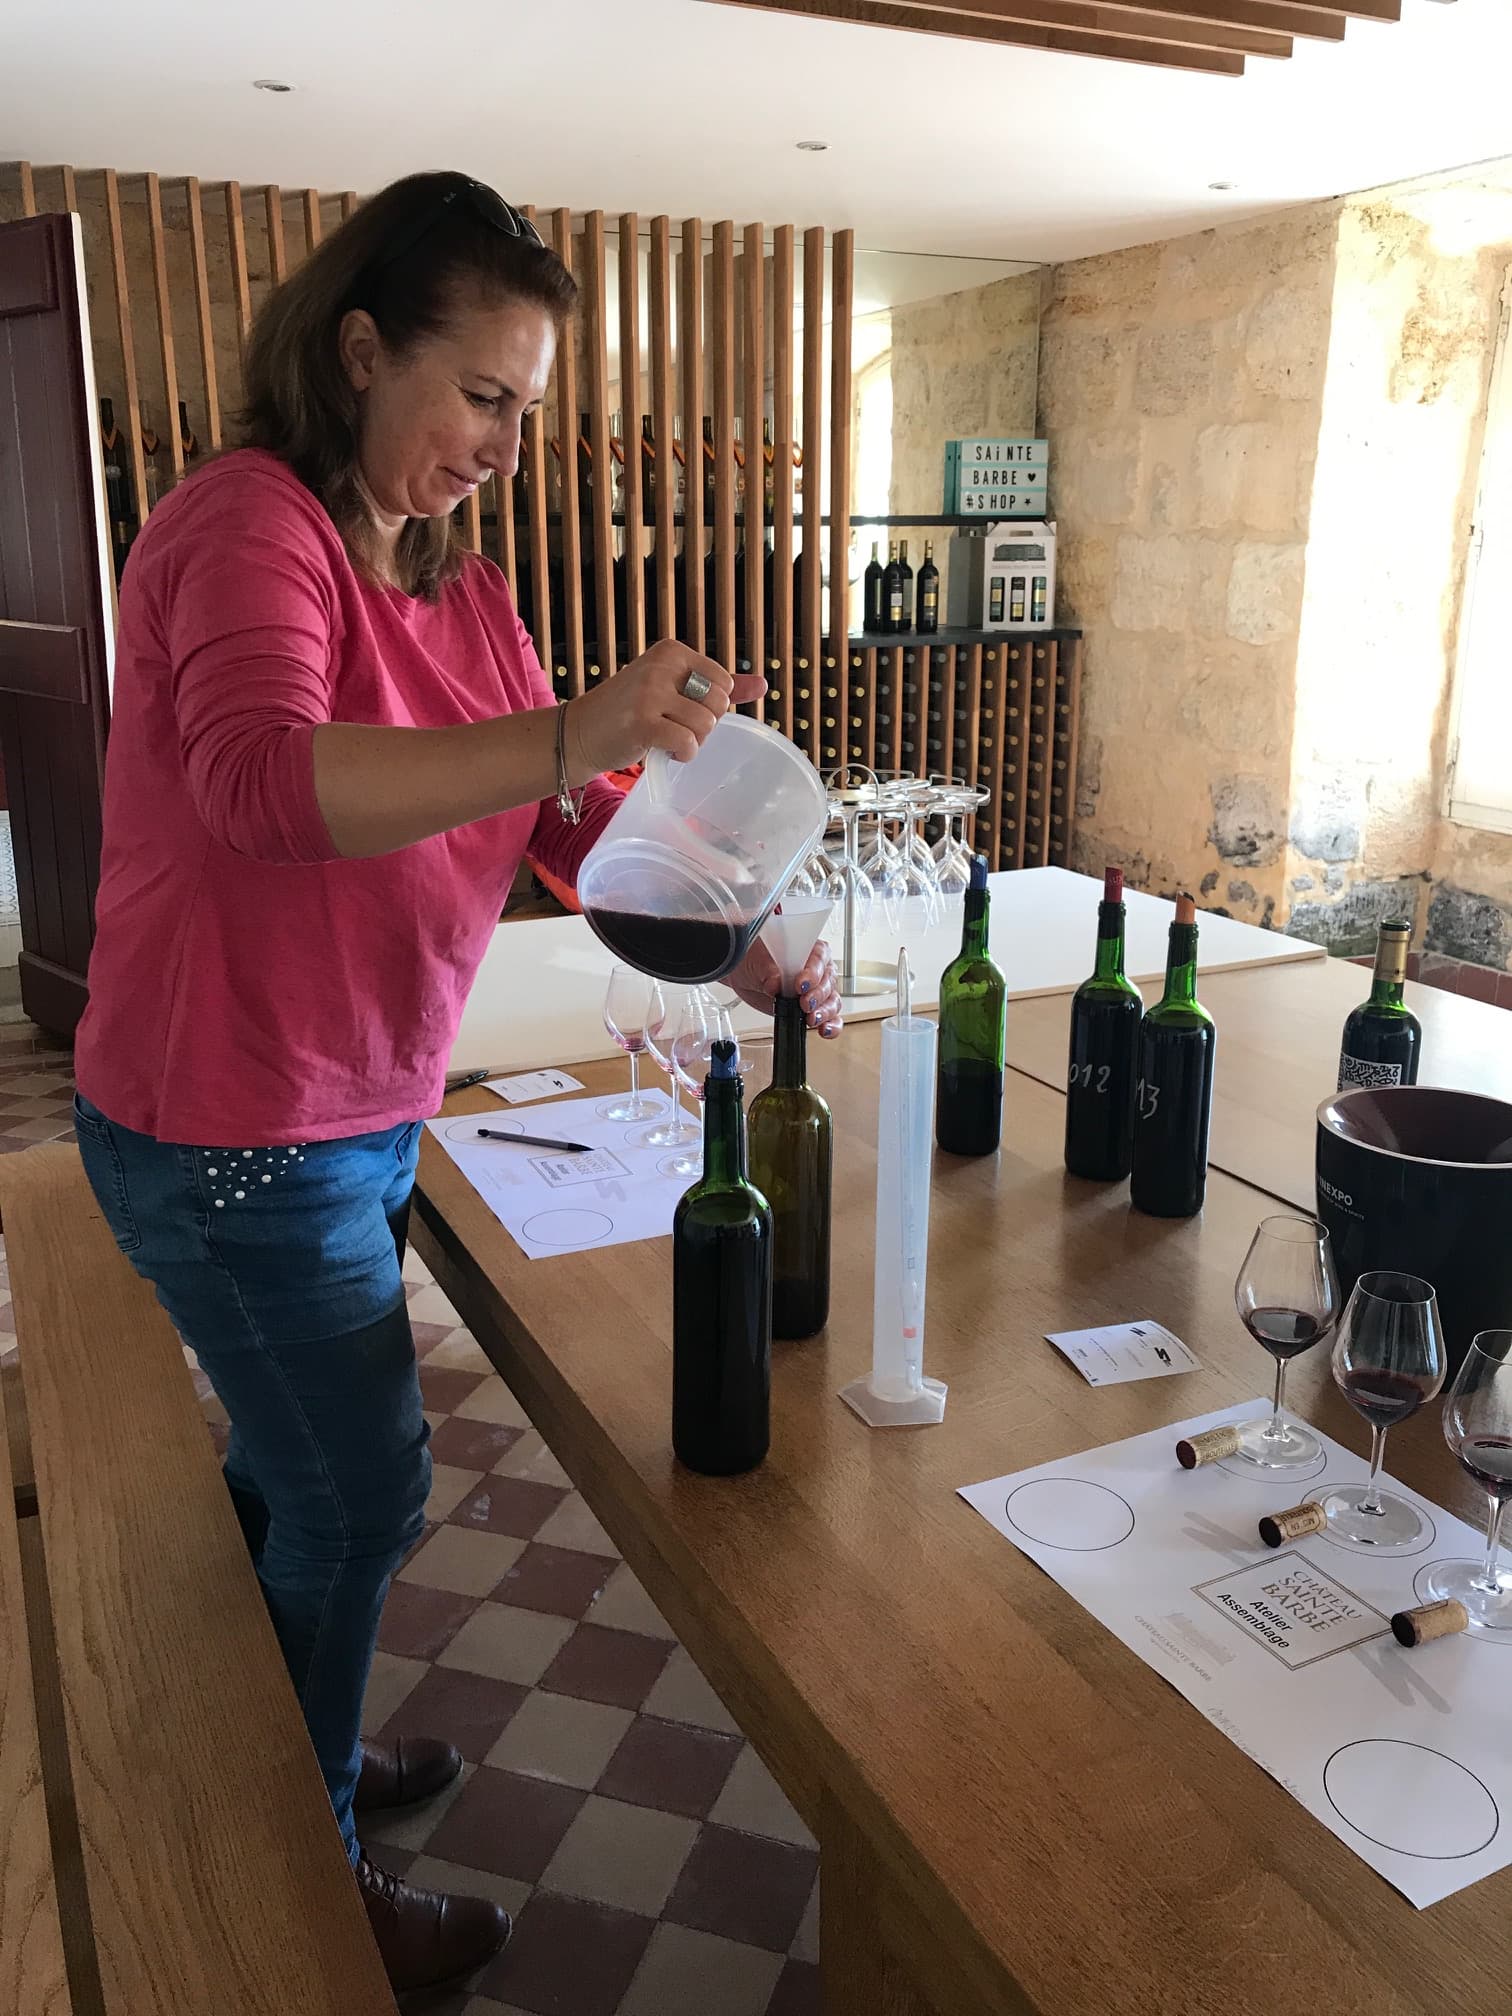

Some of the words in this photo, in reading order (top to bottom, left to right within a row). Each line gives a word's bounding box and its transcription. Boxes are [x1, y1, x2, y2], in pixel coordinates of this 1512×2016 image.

[966, 494, 1016, 509] #SHOP
[973, 470, 1017, 485] BARBE
[1249, 1601, 1293, 1631] Atelier
[1261, 1583, 1331, 1632] BARBE
[1278, 1577, 1347, 1625] SAINTE
[1293, 1570, 1362, 1619] CHÂTEAU
[1217, 1593, 1290, 1648] Assemblage
